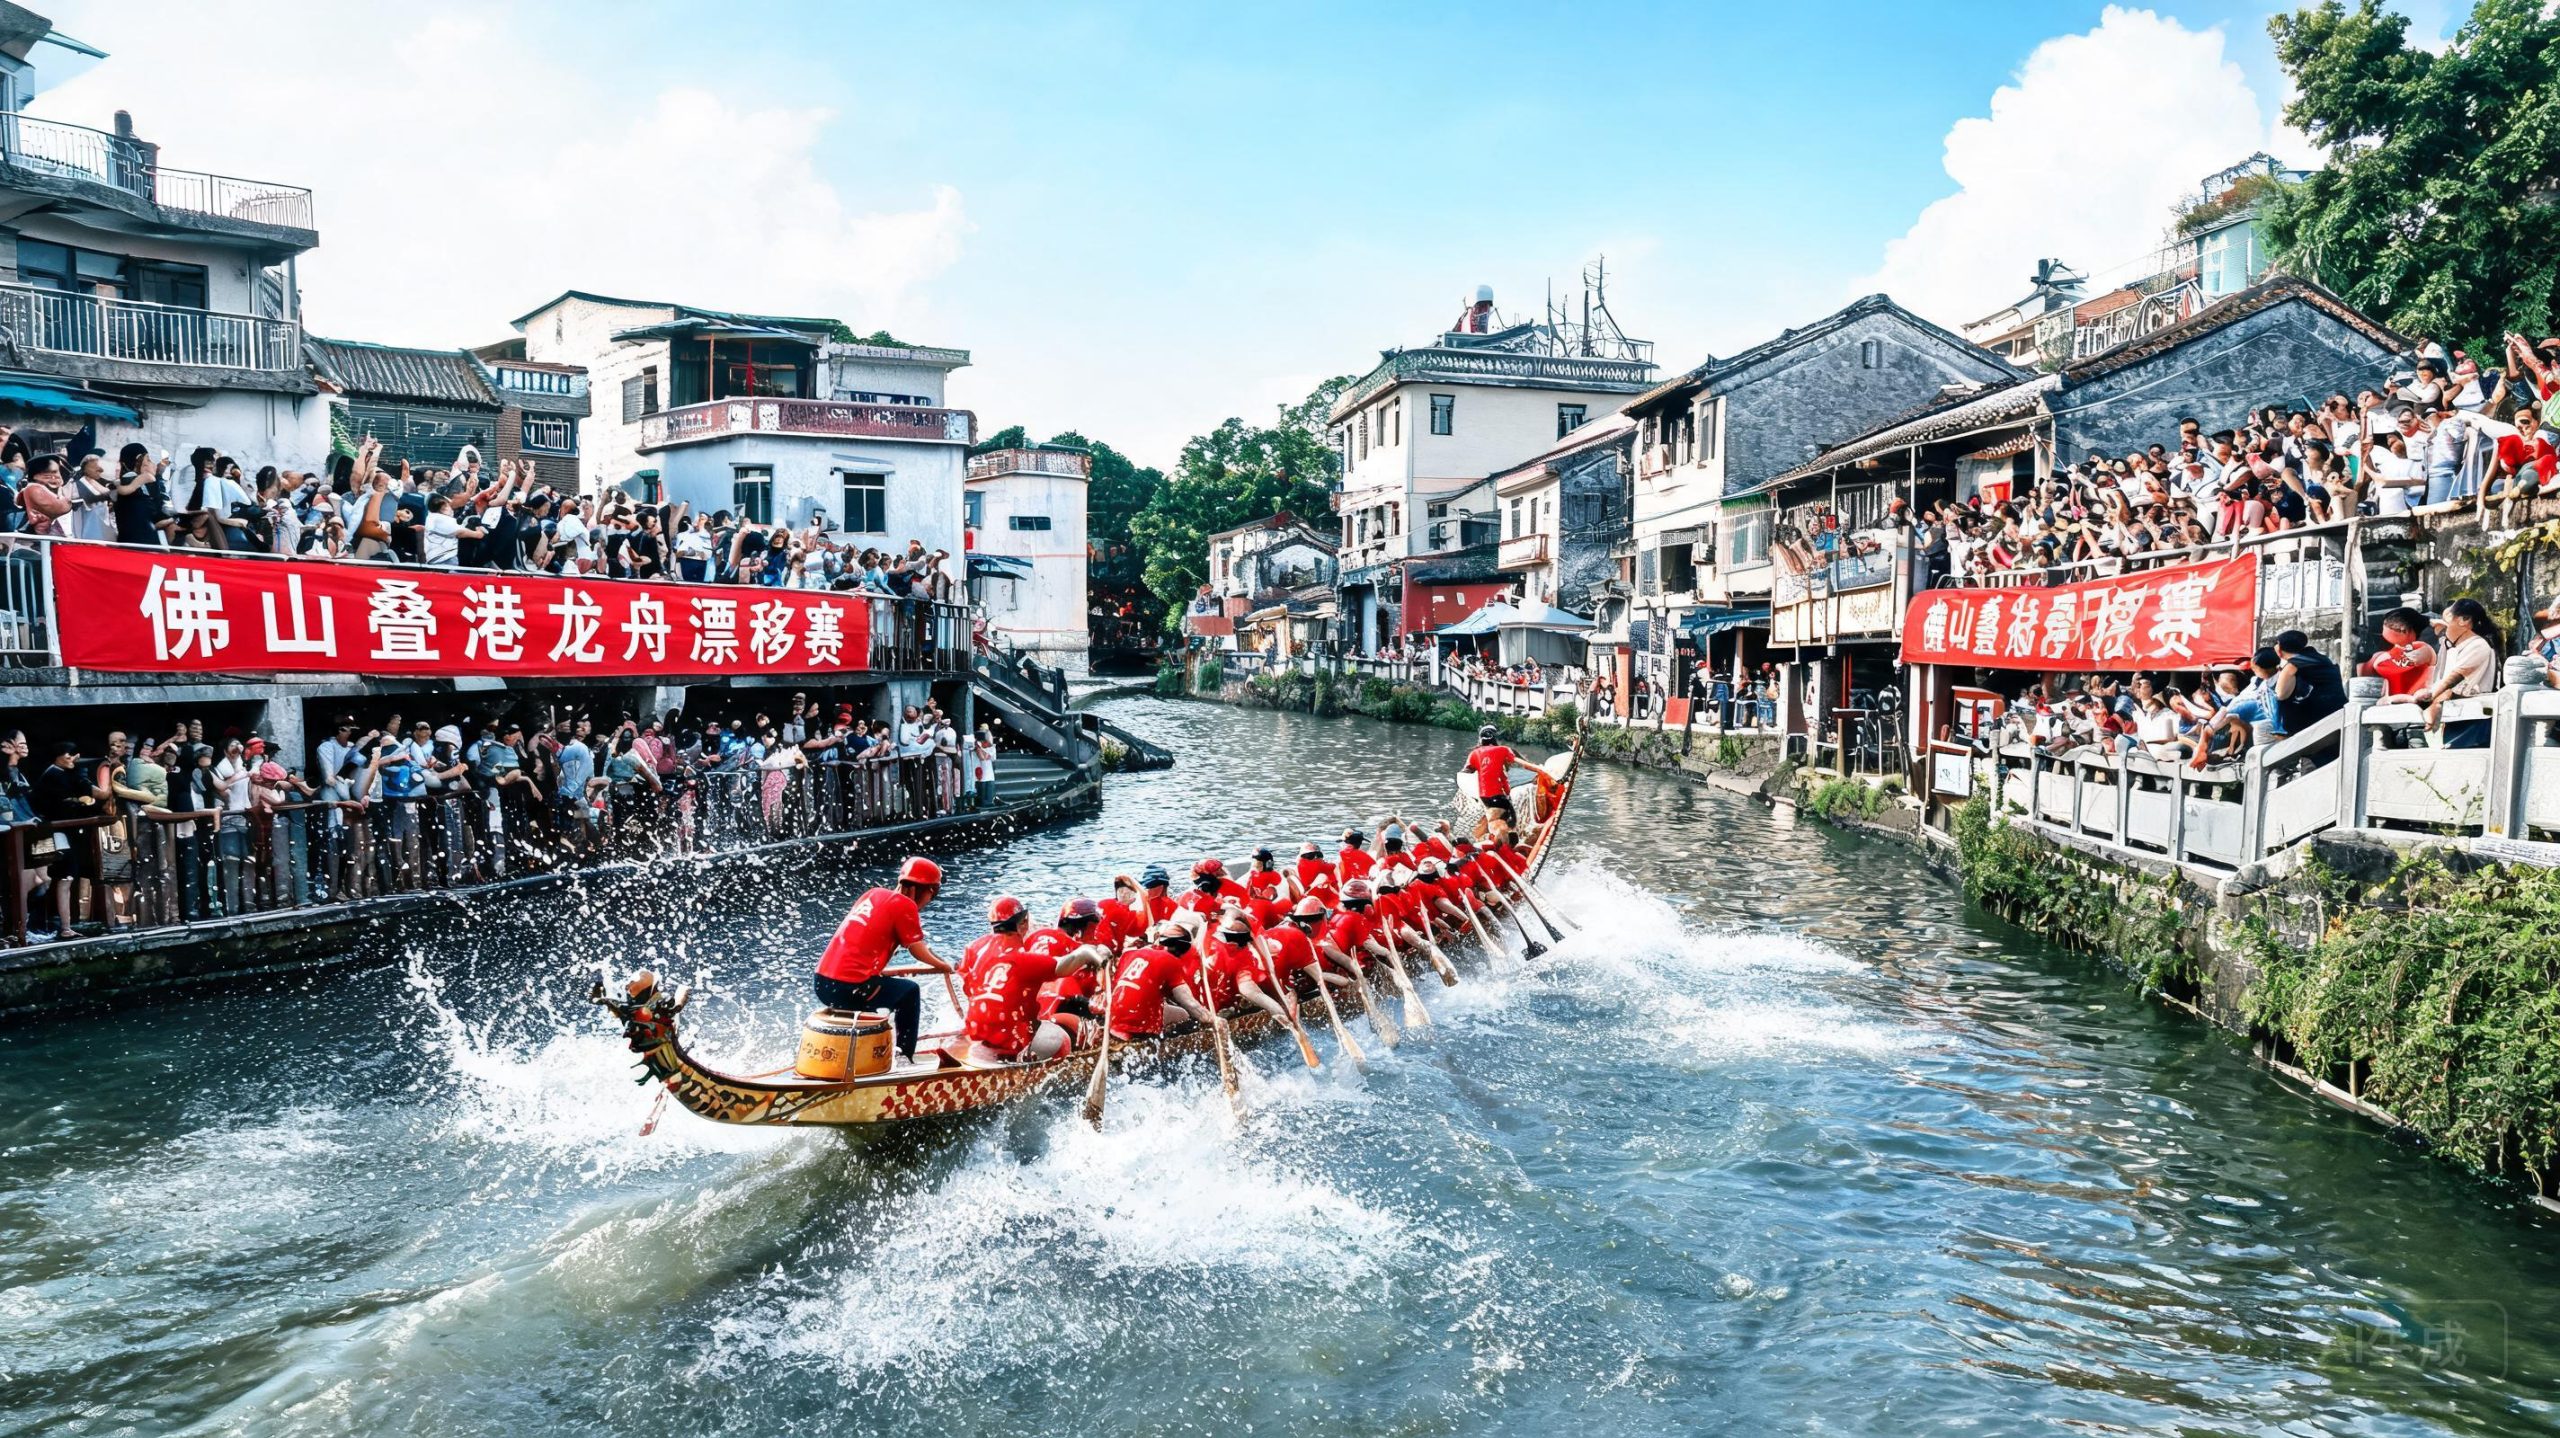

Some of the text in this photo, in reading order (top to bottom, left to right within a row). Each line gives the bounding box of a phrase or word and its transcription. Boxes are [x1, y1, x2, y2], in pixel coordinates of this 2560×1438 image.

[140, 564, 845, 665] 佛山叠港龙舟漂移赛
